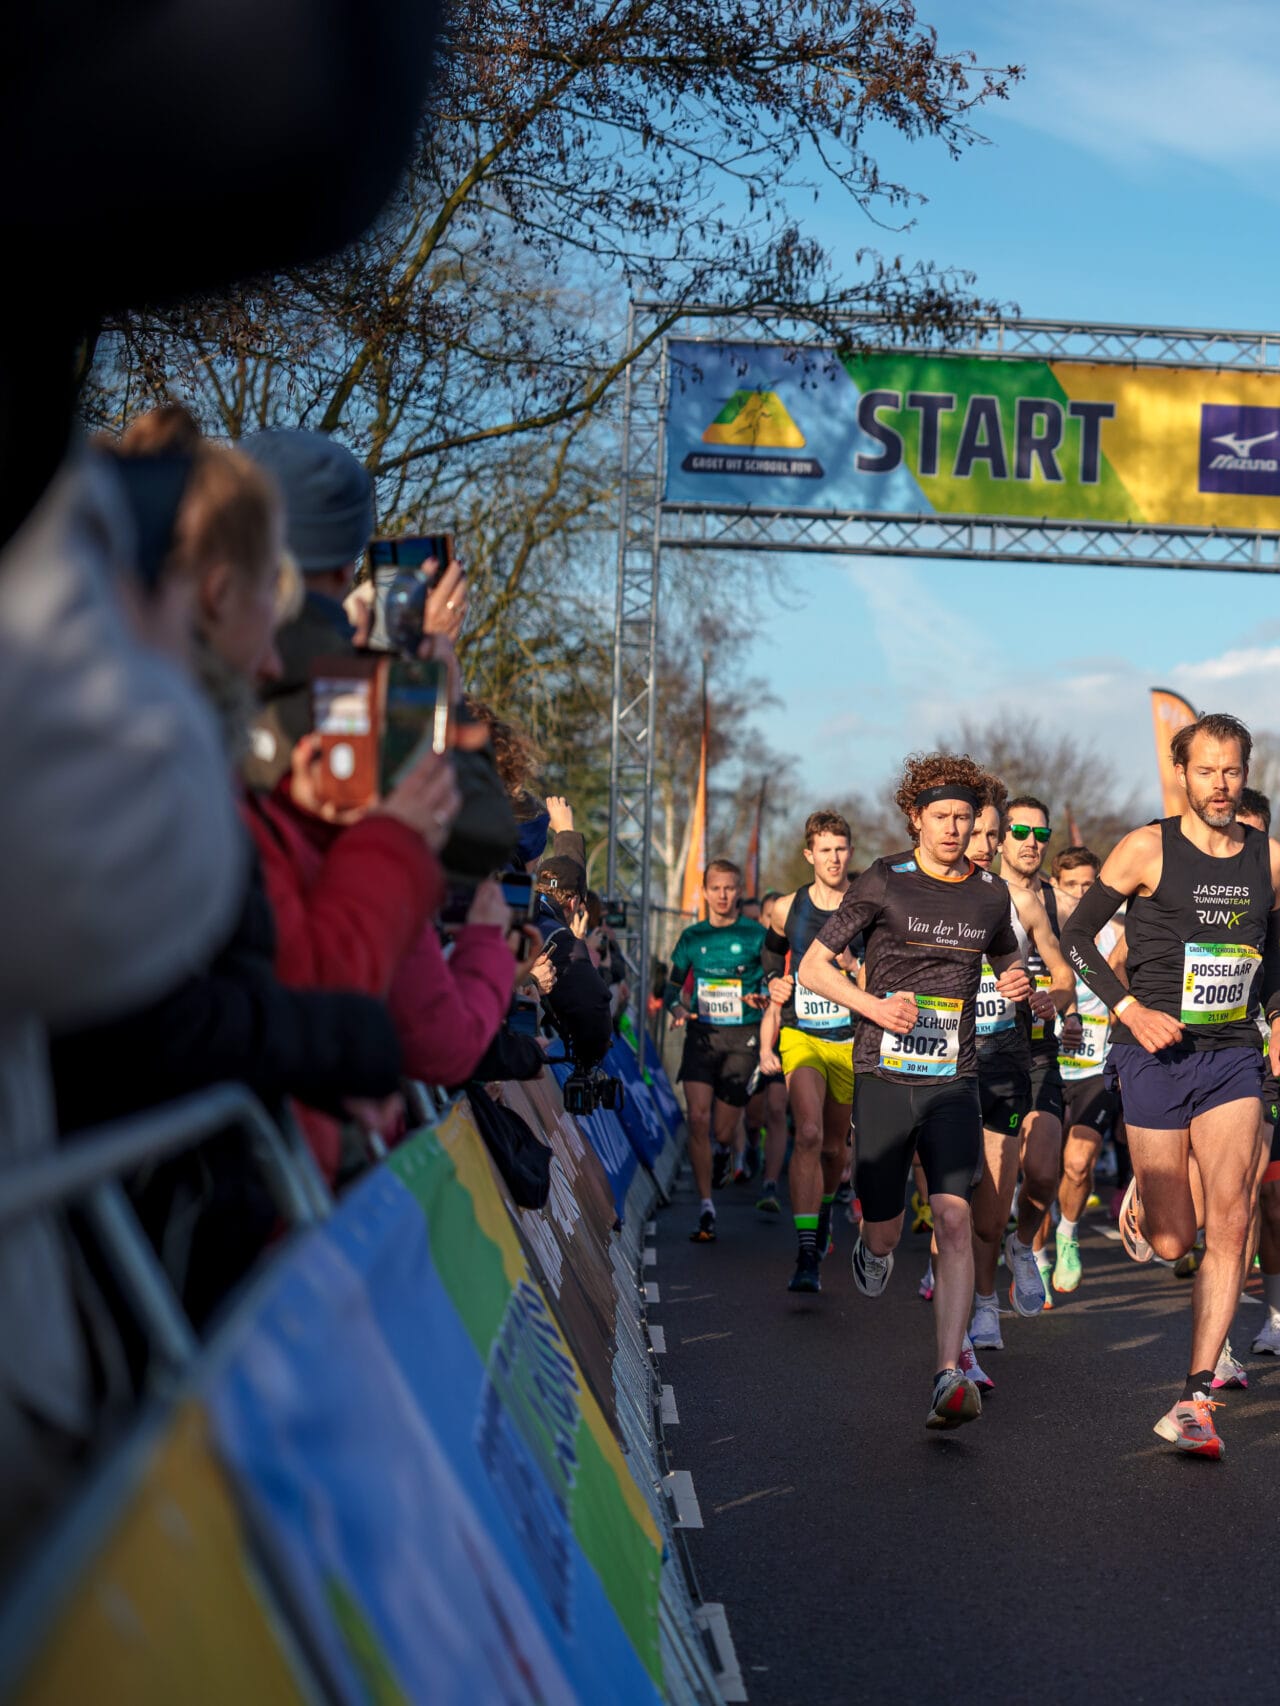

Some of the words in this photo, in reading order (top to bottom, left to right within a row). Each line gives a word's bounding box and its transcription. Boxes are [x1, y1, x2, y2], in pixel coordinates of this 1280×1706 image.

[855, 389, 1116, 485] START
[1193, 884, 1249, 897] JASPERS
[1193, 896, 1251, 905] RUNNINGTEAM
[908, 916, 930, 933] Van
[933, 920, 954, 936] der
[957, 922, 986, 940] Voort
[936, 936, 959, 946] Groep
[1192, 963, 1252, 977] BOSSELAAR
[1193, 983, 1244, 1005] 20003
[804, 1001, 839, 1014] 30173
[976, 999, 1006, 1017] 003
[1220, 1012, 1229, 1020] KM
[891, 1034, 948, 1057] 30072
[907, 1063, 916, 1071] 30
[917, 1064, 928, 1072] KM
